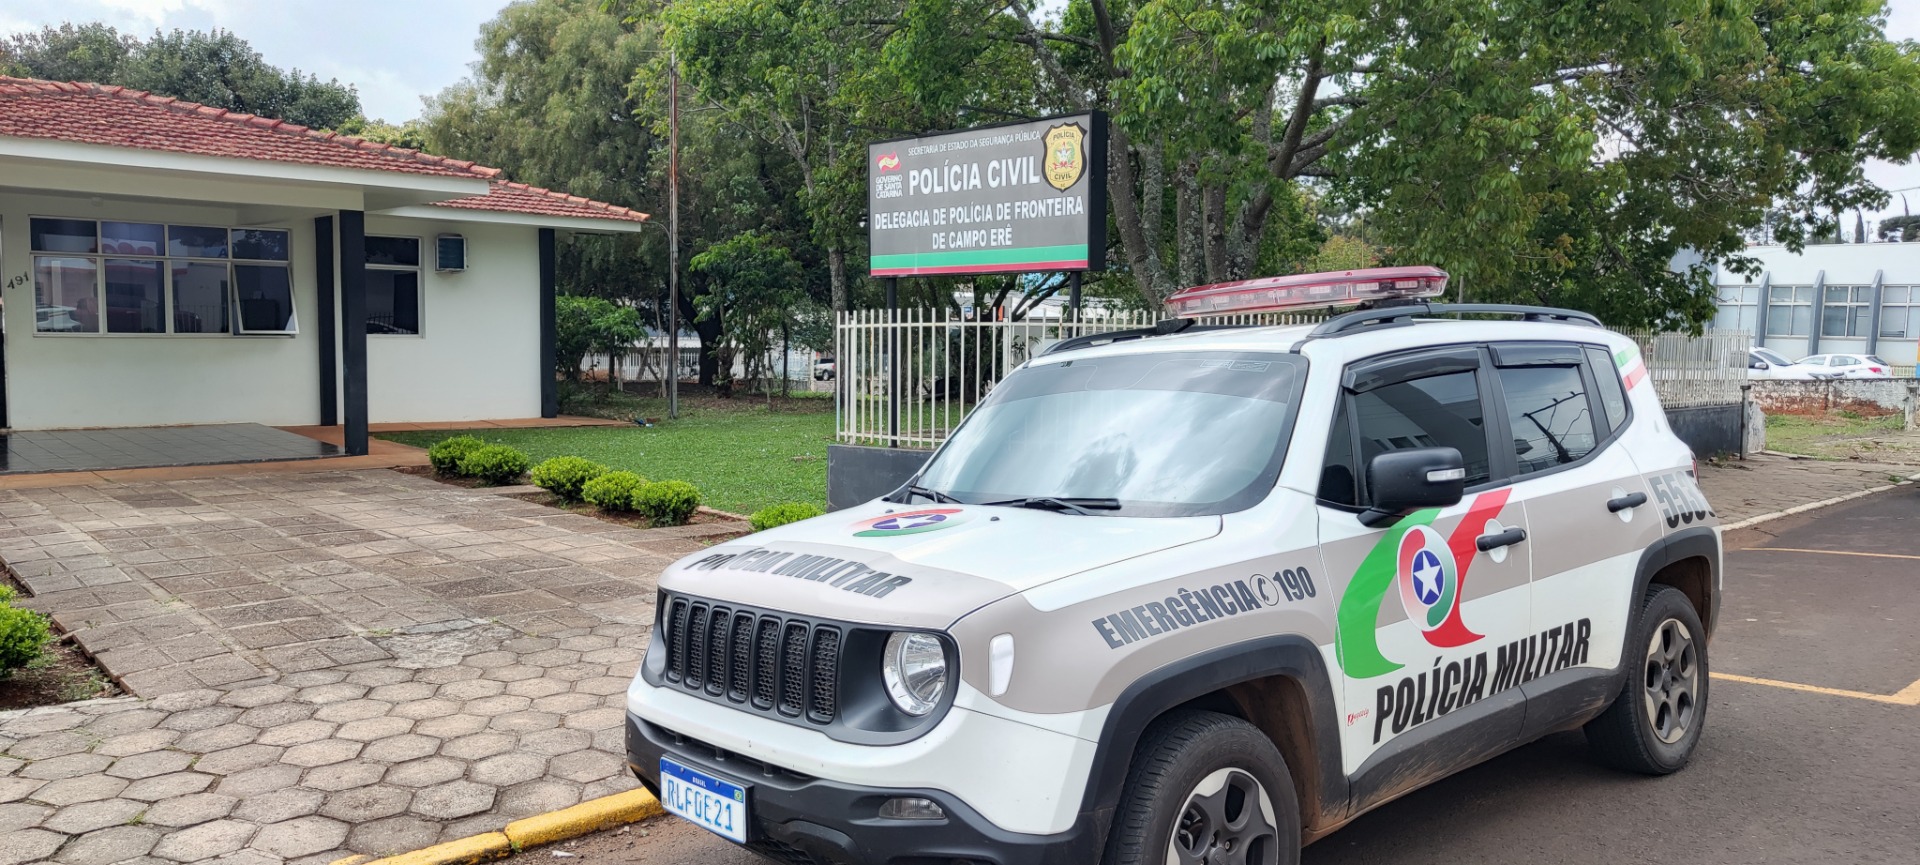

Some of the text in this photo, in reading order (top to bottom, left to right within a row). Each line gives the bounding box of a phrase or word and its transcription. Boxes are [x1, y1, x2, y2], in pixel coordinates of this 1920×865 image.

[908, 130, 1041, 156] SECRETARIA DE ESTADO DA SEGURANÇA PÚBLICA
[1053, 130, 1075, 141] POLÍCIA
[875, 174, 903, 184] GOVERNO
[909, 156, 1041, 196] POLÍCIA CIVIL
[875, 189, 903, 199] CATARINA
[875, 195, 1084, 230] DELEGACIA DE POLÍCIA DE FRONTEIRA
[932, 223, 1013, 250] DE CAMPO ERÊ
[771, 553, 913, 599] MILITAR
[1091, 566, 1317, 650] EMERGÊNCIA 190
[1373, 617, 1592, 745] POLÍCIA MILITAR
